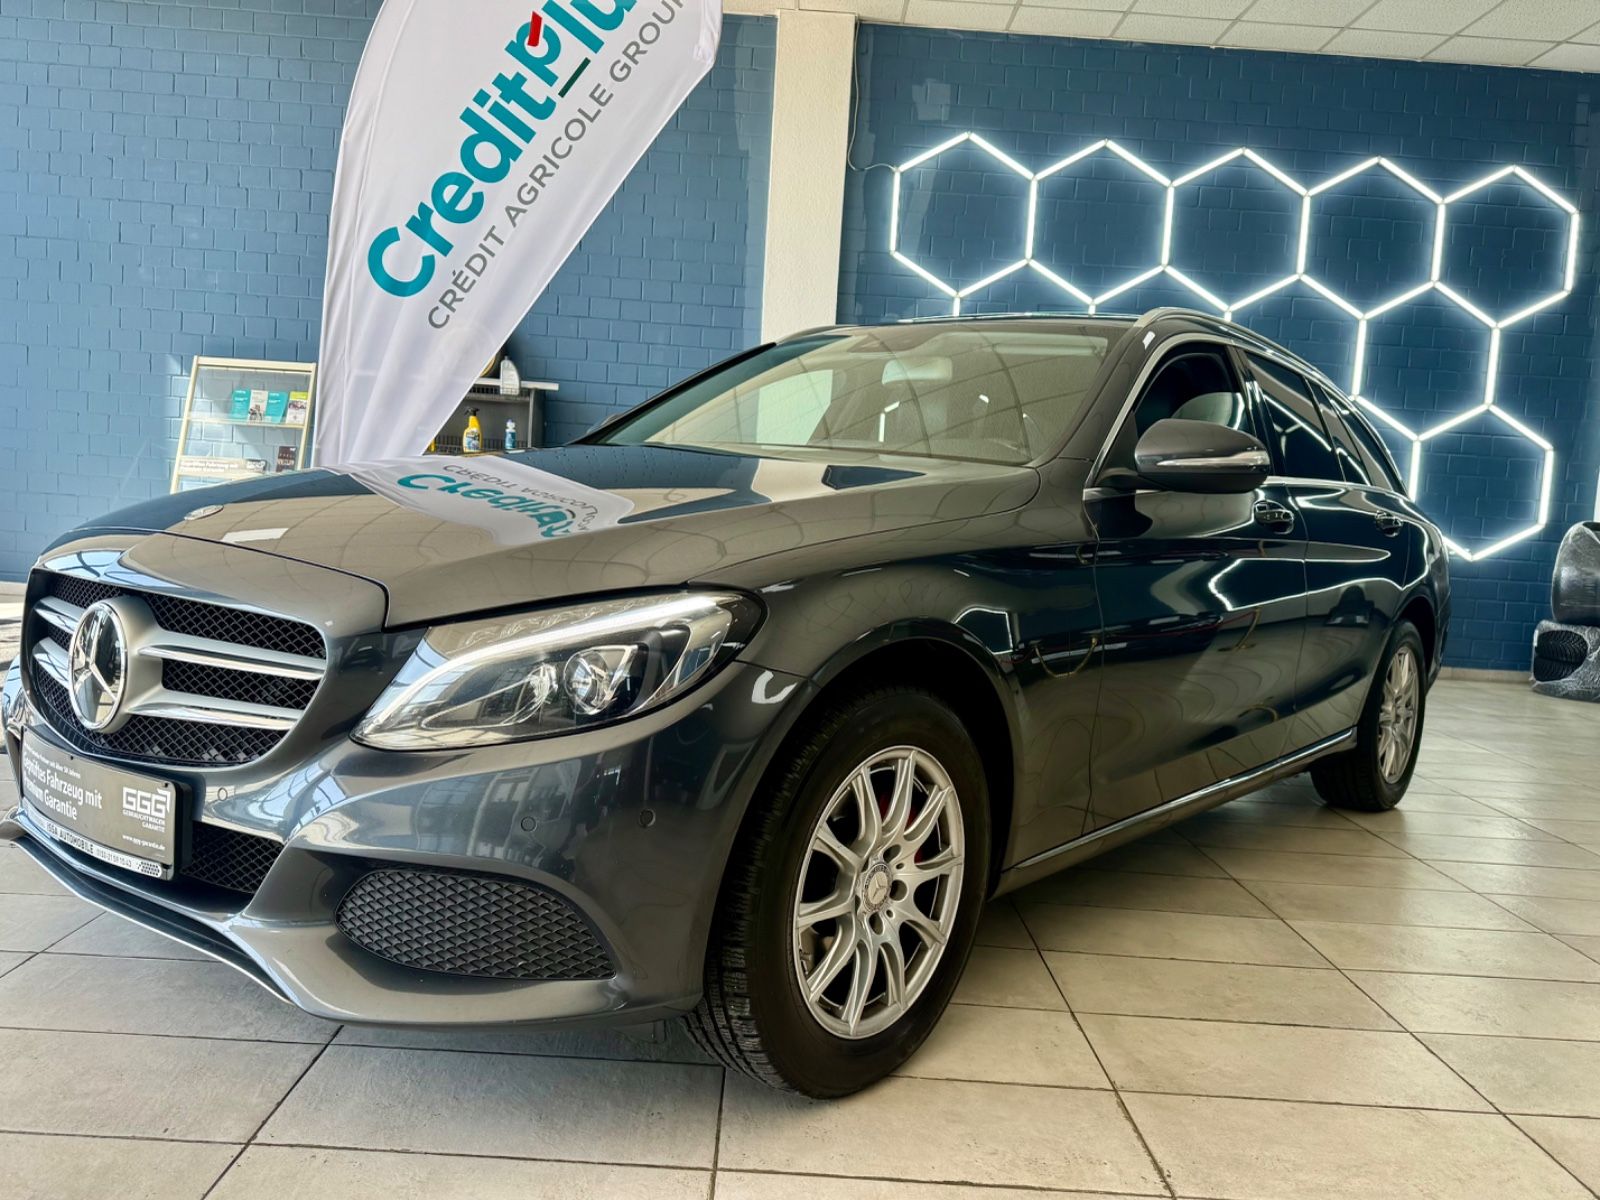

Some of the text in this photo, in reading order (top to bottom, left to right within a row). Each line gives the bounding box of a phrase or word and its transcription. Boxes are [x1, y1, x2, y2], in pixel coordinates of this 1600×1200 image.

[428, 225, 505, 330] CRÉDIT
[504, 83, 614, 227] AGRICOLE
[44, 789, 77, 820] Garantie
[46, 769, 84, 806] Fahrzeug
[85, 789, 102, 809] mit
[122, 787, 166, 818] GGG
[59, 829, 94, 854] AUTOMOBILE
